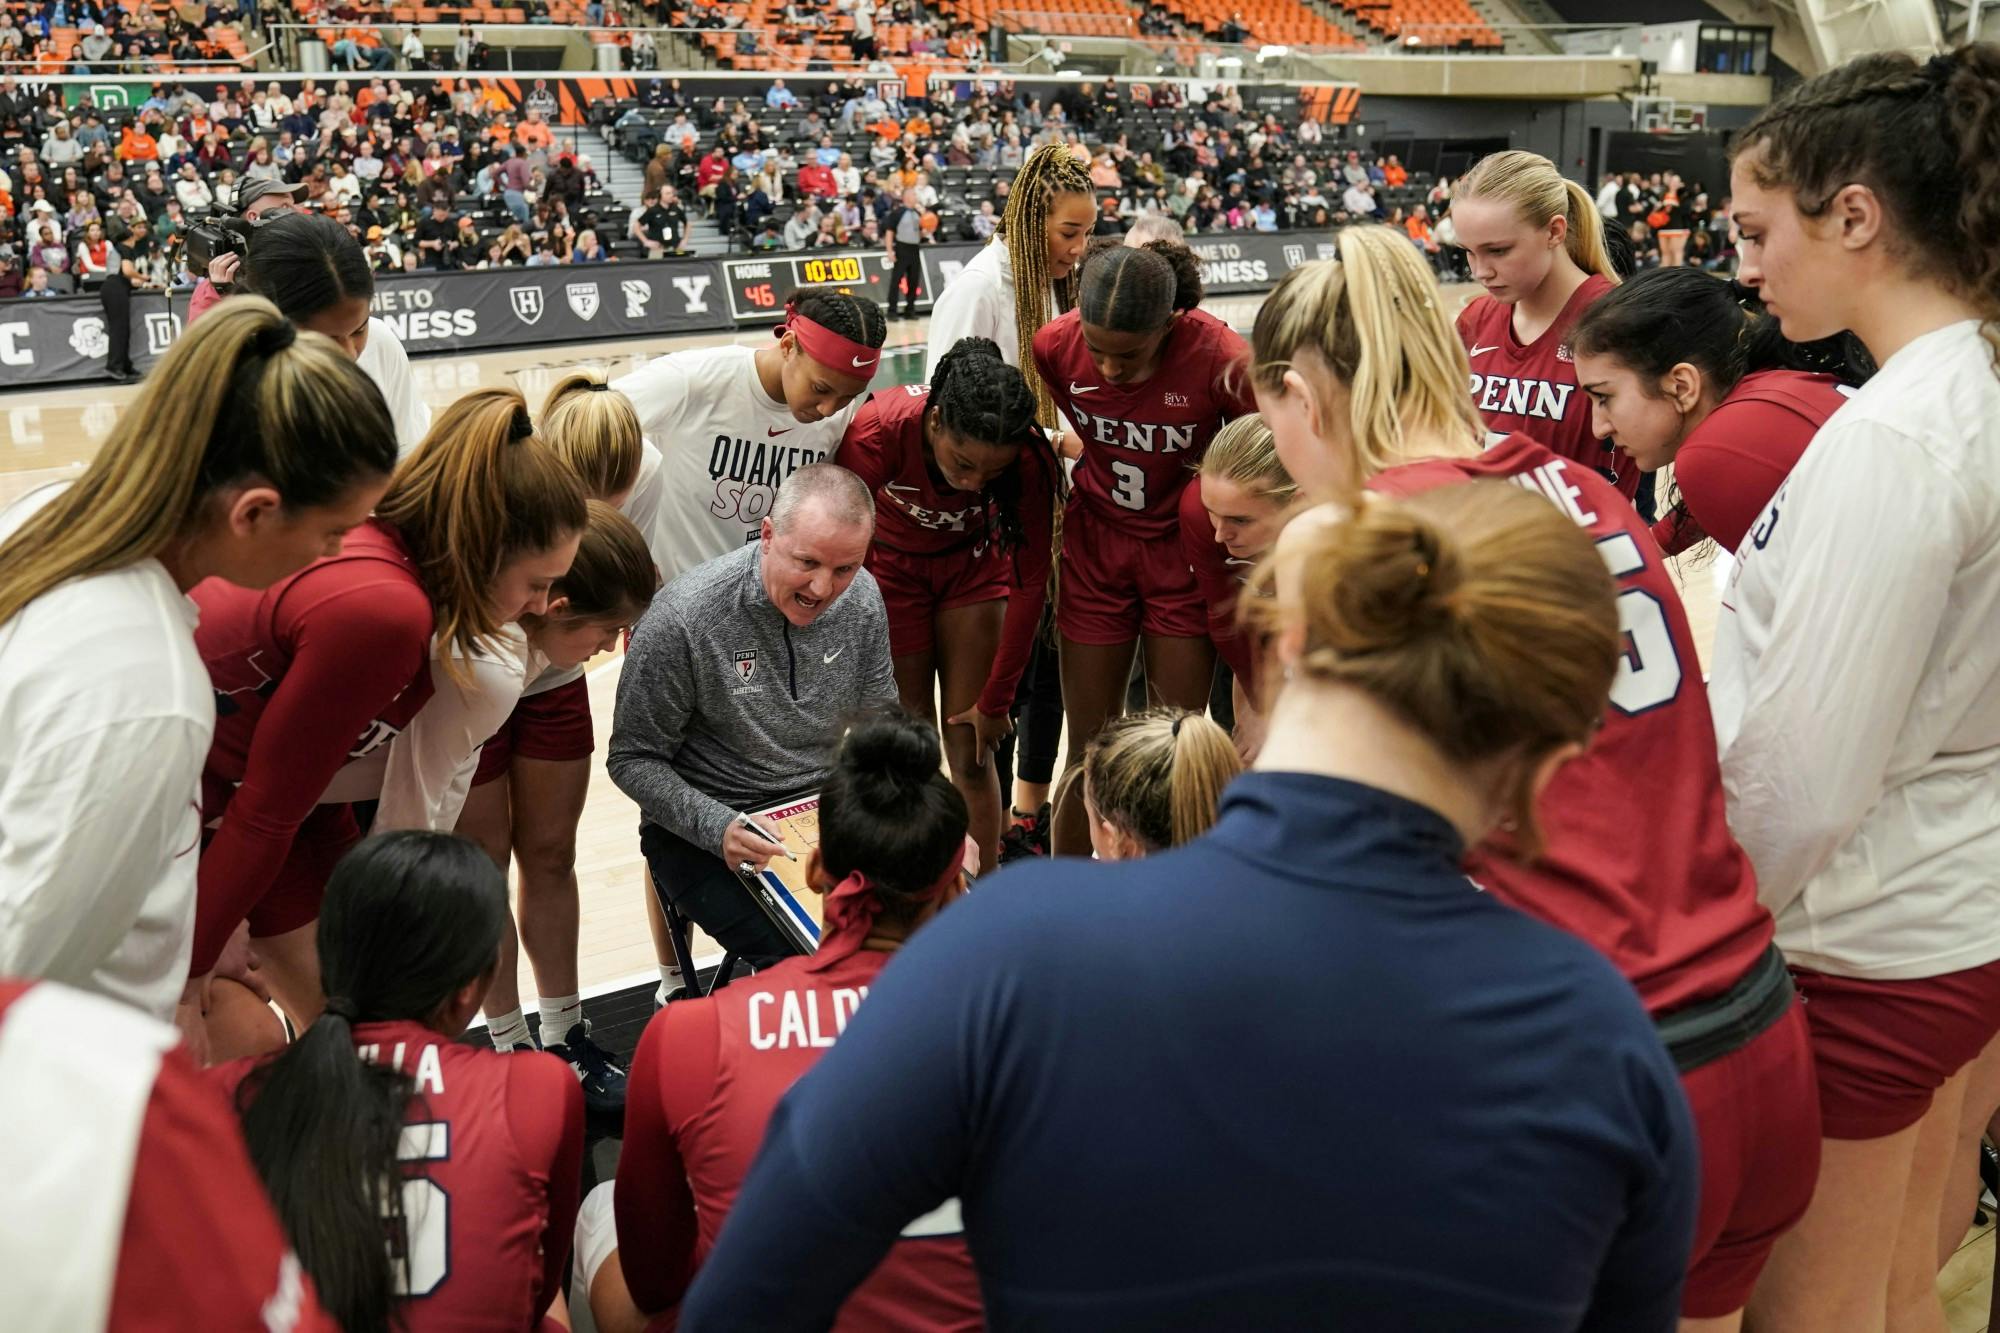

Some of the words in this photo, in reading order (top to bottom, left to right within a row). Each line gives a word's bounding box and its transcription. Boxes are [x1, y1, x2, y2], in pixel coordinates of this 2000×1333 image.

[1219, 244, 1240, 259] TO
[734, 264, 772, 280] HOME
[805, 258, 860, 283] 10:00
[399, 289, 433, 309] TO
[518, 291, 538, 314] H
[621, 280, 652, 318] P
[672, 275, 711, 313] Y
[744, 284, 776, 307] 46
[0, 321, 35, 366] C
[1111, 461, 1146, 511] 3
[736, 652, 755, 660] PENN
[749, 986, 869, 1050] CALD
